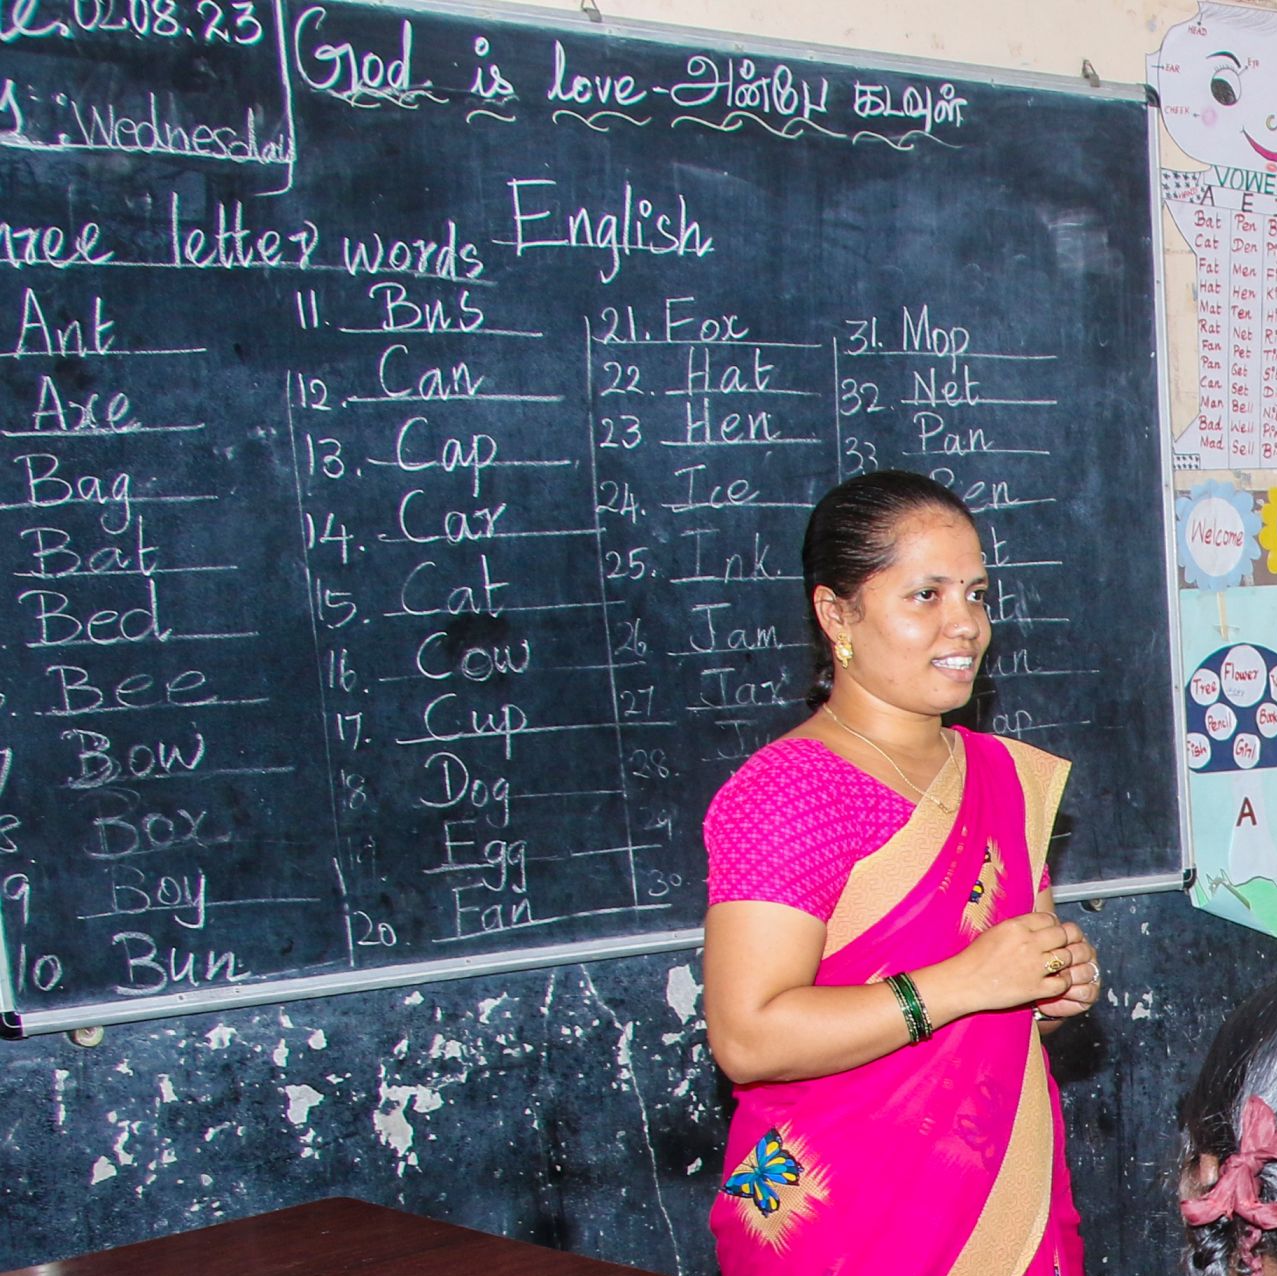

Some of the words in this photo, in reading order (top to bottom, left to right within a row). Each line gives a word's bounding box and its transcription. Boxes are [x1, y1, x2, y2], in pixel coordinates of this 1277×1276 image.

[296, 7, 432, 95] God
[471, 37, 516, 98] is
[548, 41, 647, 105] love
[1194, 210, 1221, 229] Bat
[1235, 214, 1256, 231] Pen
[1200, 185, 1215, 206] A
[1241, 193, 1254, 212] E
[506, 177, 714, 283] English
[1195, 234, 1219, 249] Cat
[1199, 258, 1219, 273] Fat
[1200, 279, 1221, 294] Hat
[15, 288, 115, 358] Ant
[667, 297, 749, 342] Fox
[903, 304, 969, 374] Mop
[380, 345, 484, 399] Can
[688, 346, 774, 397] Hat
[914, 368, 980, 405] Net
[34, 376, 142, 431] Axe
[687, 398, 781, 444] Hen
[396, 417, 497, 498] Cap
[913, 411, 993, 454] Pan
[14, 453, 131, 533] Bag
[674, 465, 759, 508] Ice
[398, 490, 506, 543] Car
[1191, 521, 1244, 547] Welcome
[21, 515, 160, 579] Bat
[401, 555, 509, 617] Cat
[19, 579, 173, 646] Bed
[690, 603, 786, 652] Jam
[416, 631, 530, 681] Cow
[1225, 663, 1259, 681] Flower
[46, 665, 208, 716] Bee
[1193, 678, 1216, 695] Tree
[424, 694, 528, 759] Cup
[1208, 712, 1231, 732] Pencil
[61, 728, 204, 790] Bow
[421, 752, 512, 826] Dog
[1236, 797, 1257, 826] A
[441, 821, 529, 891] Egg
[112, 932, 250, 994] Bun
